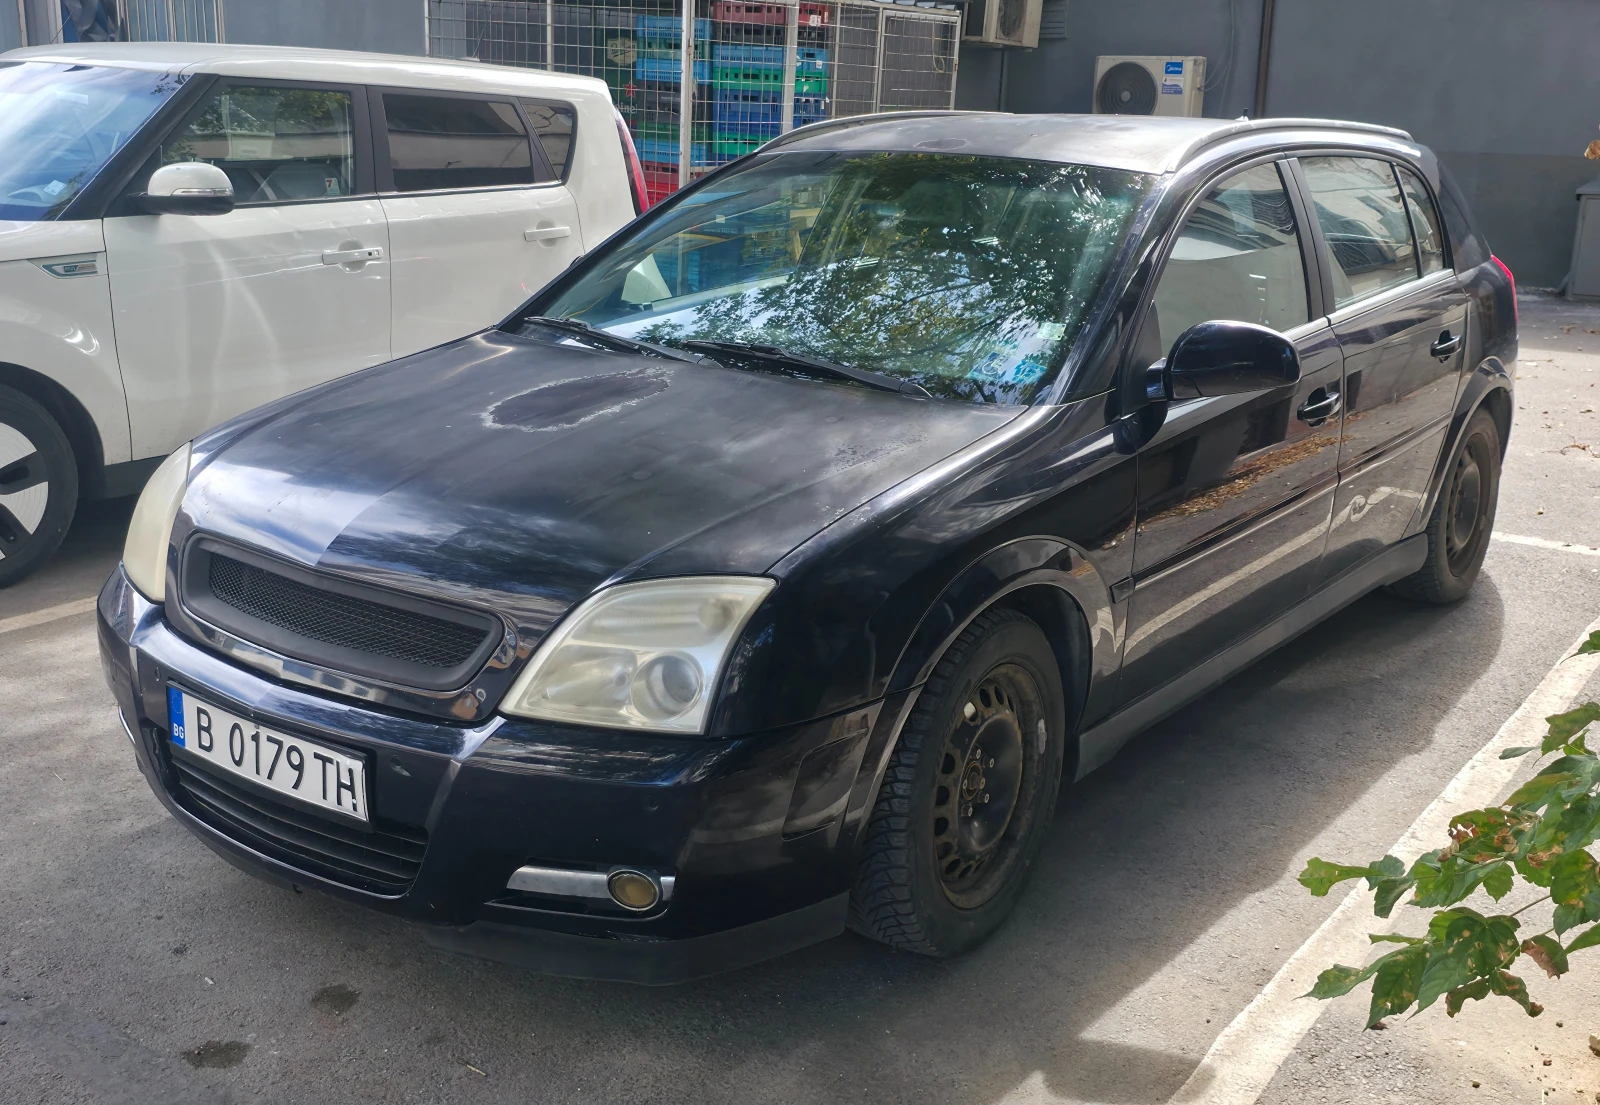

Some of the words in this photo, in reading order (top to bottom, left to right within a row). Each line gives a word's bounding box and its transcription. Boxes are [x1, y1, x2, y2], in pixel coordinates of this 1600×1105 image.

[173, 722, 185, 739] BG
[196, 706, 214, 753] B
[229, 722, 305, 790] 0179
[314, 751, 358, 812] TH
